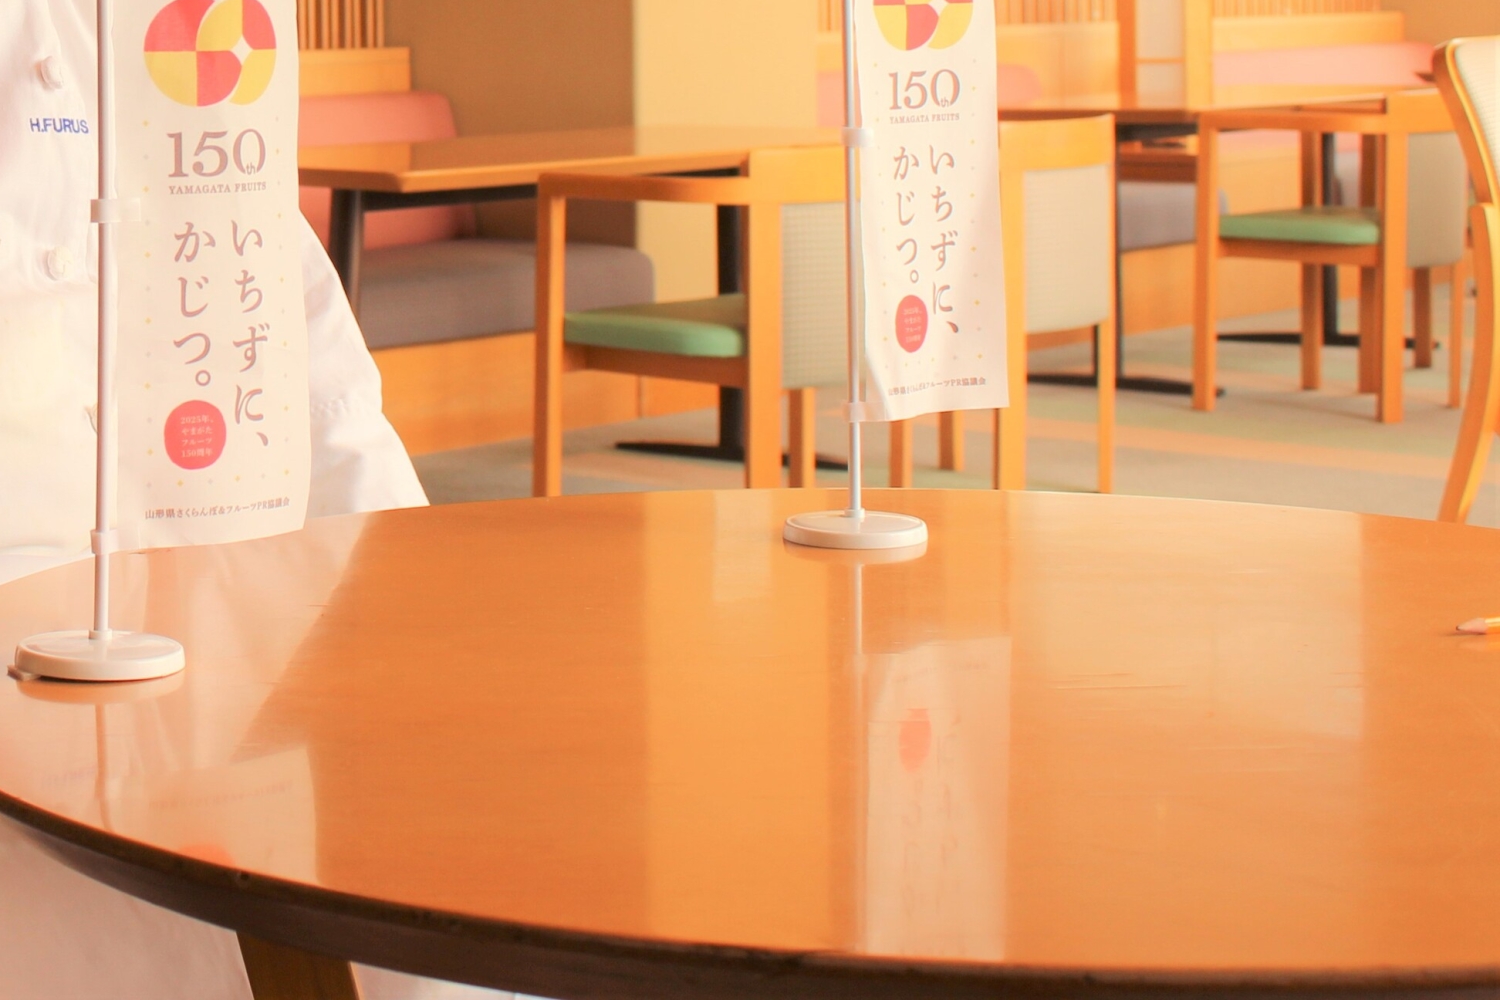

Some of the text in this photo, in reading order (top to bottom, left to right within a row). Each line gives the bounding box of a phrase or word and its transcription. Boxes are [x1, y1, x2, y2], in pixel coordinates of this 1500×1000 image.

[168, 181, 267, 195] YAMAGATA FRUITS
[889, 113, 960, 124] YAMAGATA FRUITS
[894, 146, 920, 284] かじつ。
[928, 144, 960, 333] いちずに、
[173, 221, 217, 386] かじつ。
[231, 219, 270, 447] いちずに、
